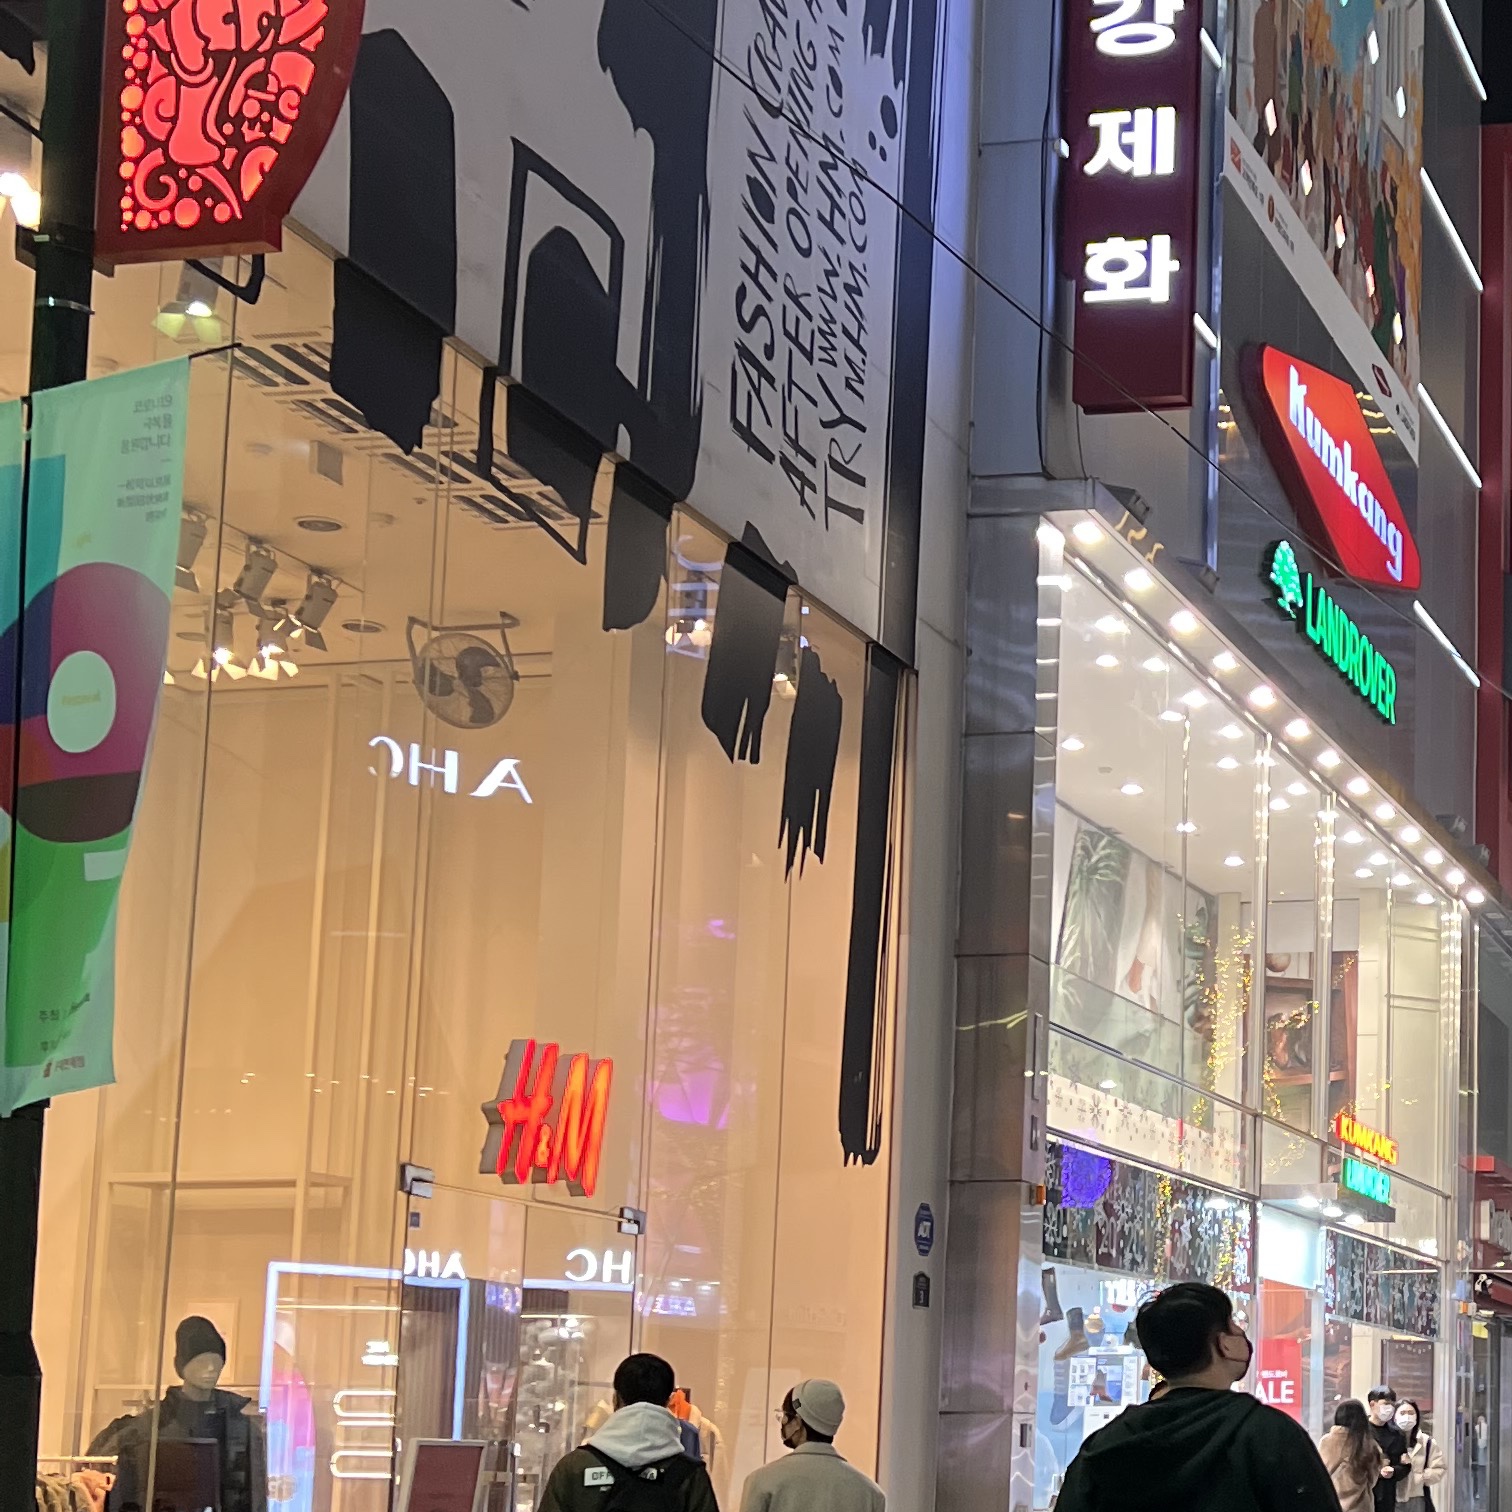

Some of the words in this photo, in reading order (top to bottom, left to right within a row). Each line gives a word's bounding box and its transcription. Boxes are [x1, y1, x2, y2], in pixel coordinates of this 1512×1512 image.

[785, 19, 818, 258] OPENING
[730, 104, 778, 465] FASHION
[779, 272, 819, 520] AFTER
[816, 373, 868, 531] TRY
[1305, 572, 1397, 725] LANDROVER
[496, 1038, 614, 1198] H&M
[1340, 1114, 1399, 1166] KUMKANG
[1255, 1380, 1295, 1405] ALE
